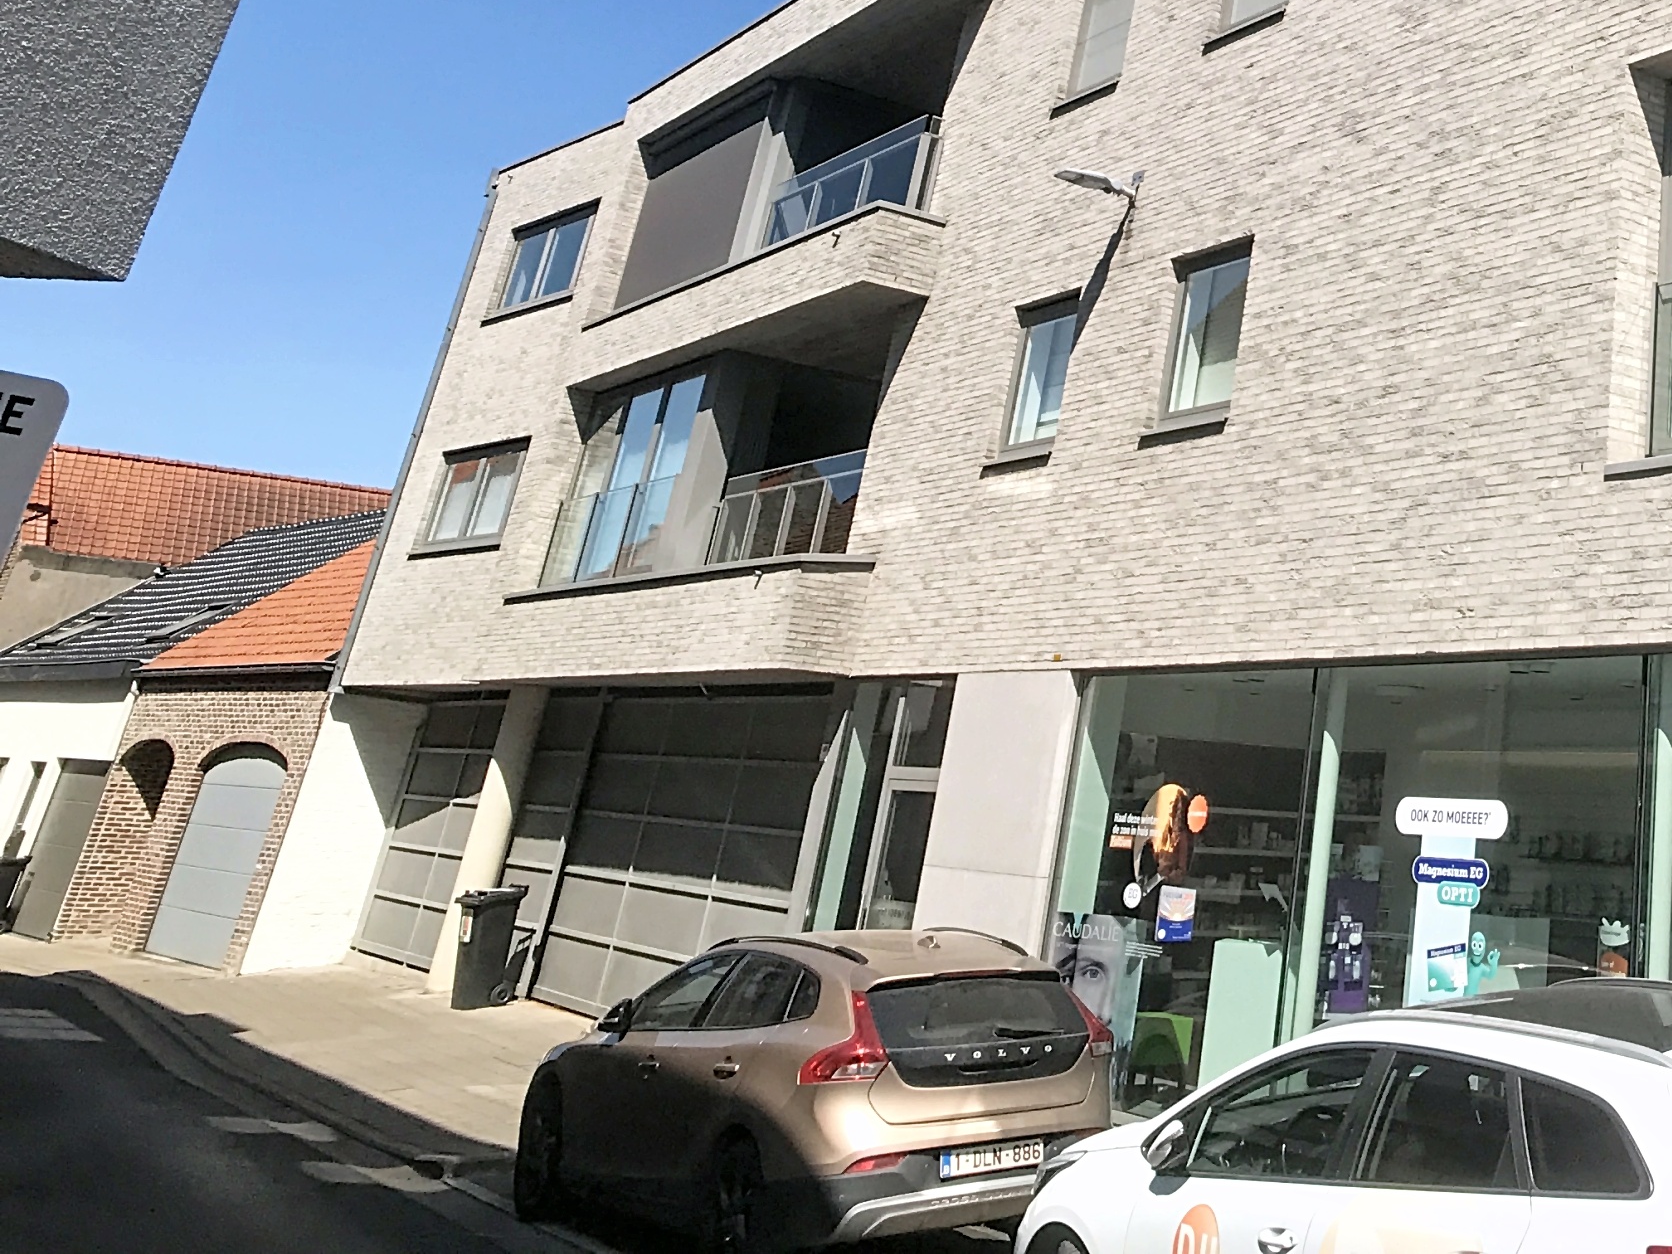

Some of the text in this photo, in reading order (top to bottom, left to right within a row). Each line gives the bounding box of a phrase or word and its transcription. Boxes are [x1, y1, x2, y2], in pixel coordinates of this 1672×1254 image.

[0, 392, 35, 436] E
[1410, 809, 1430, 822] OOK
[1432, 810, 1444, 823] ZO
[1418, 863, 1484, 879] Magnesium EG
[1441, 886, 1474, 902] OPTI
[944, 1044, 1053, 1062] VOLVO
